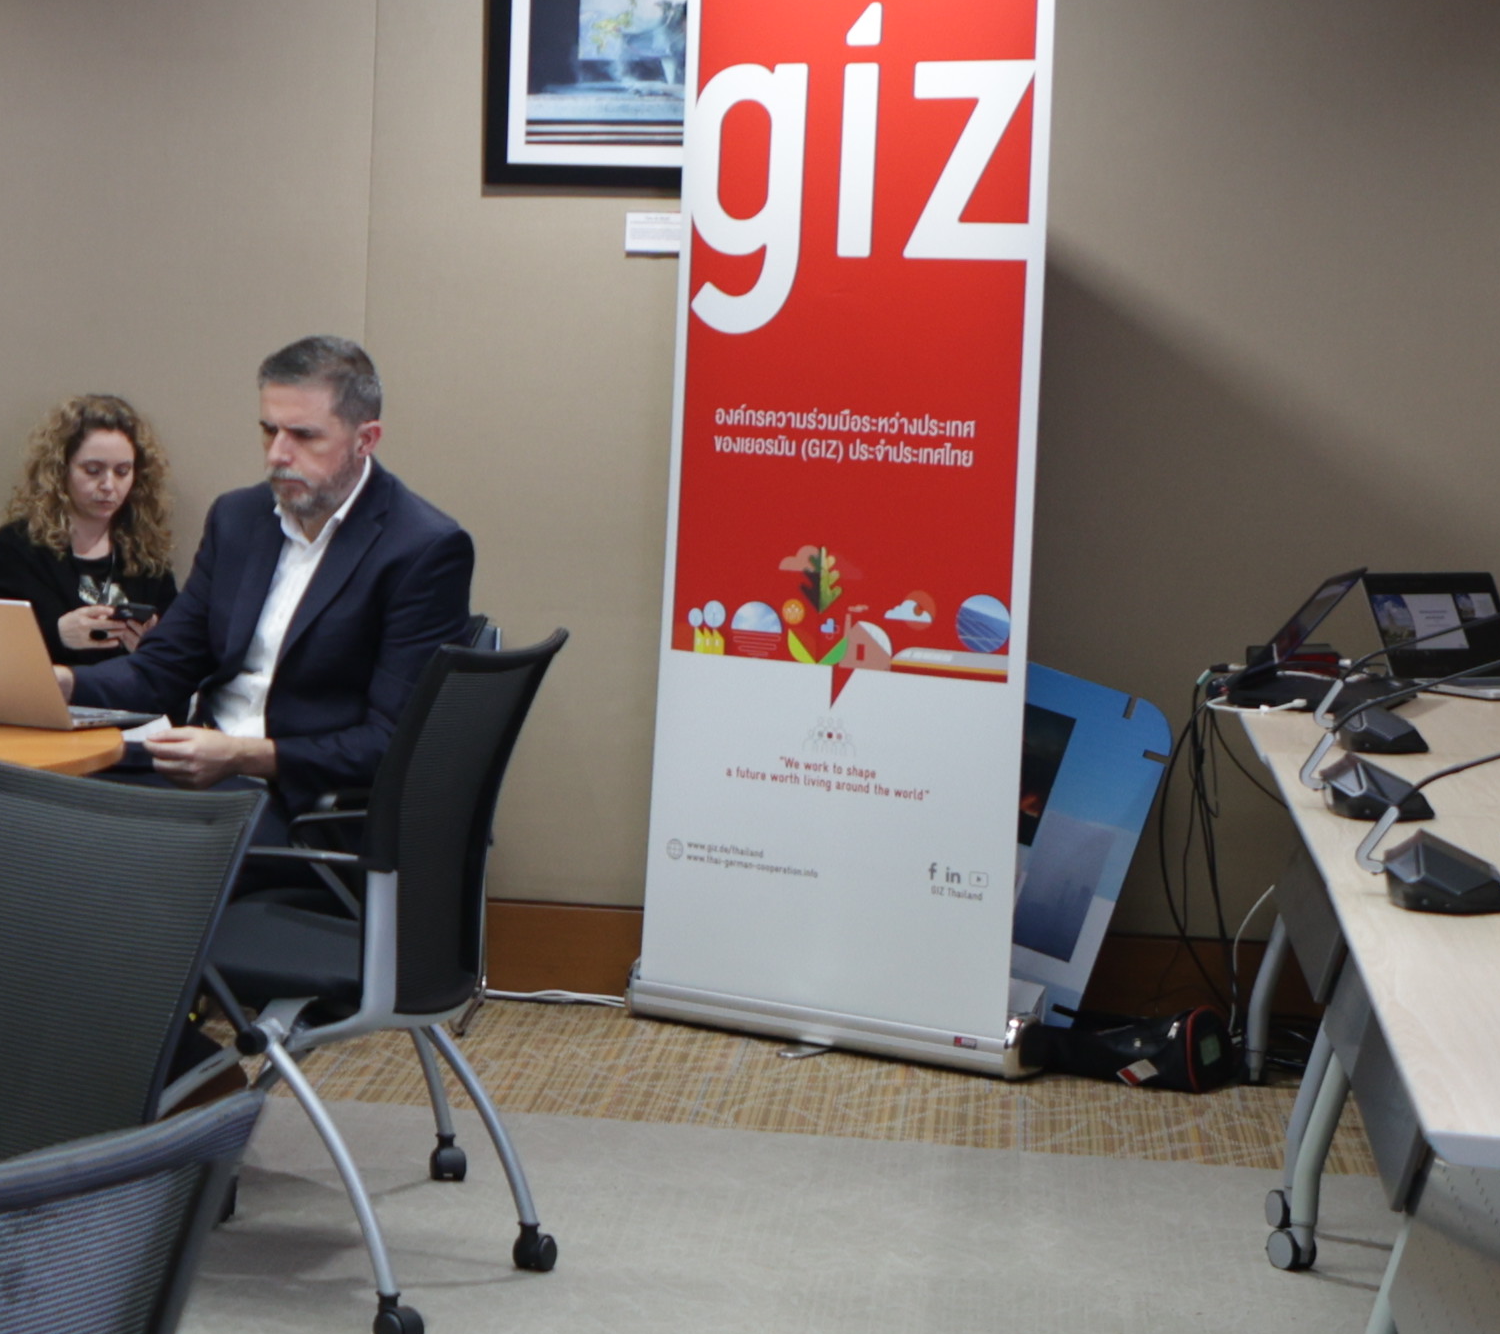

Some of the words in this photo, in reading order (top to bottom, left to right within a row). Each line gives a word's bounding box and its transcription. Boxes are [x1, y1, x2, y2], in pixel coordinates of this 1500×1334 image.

[690, 1, 1037, 335] giz
[714, 403, 976, 438] องค์กรความร่วมมือระหว่างประเทศ
[801, 437, 844, 463] (GIZ)
[848, 438, 974, 468] ประจำประเทศไทย
[726, 768, 732, 777] a
[735, 766, 766, 781] future
[770, 771, 800, 785] worth
[803, 774, 832, 792] living
[835, 781, 870, 794] around
[874, 784, 890, 797] the
[804, 758, 828, 773] work
[832, 763, 843, 775] to
[846, 765, 877, 781] shape
[686, 854, 818, 878] www.thai-german-cooperation.info
[948, 887, 983, 901] Thailand
